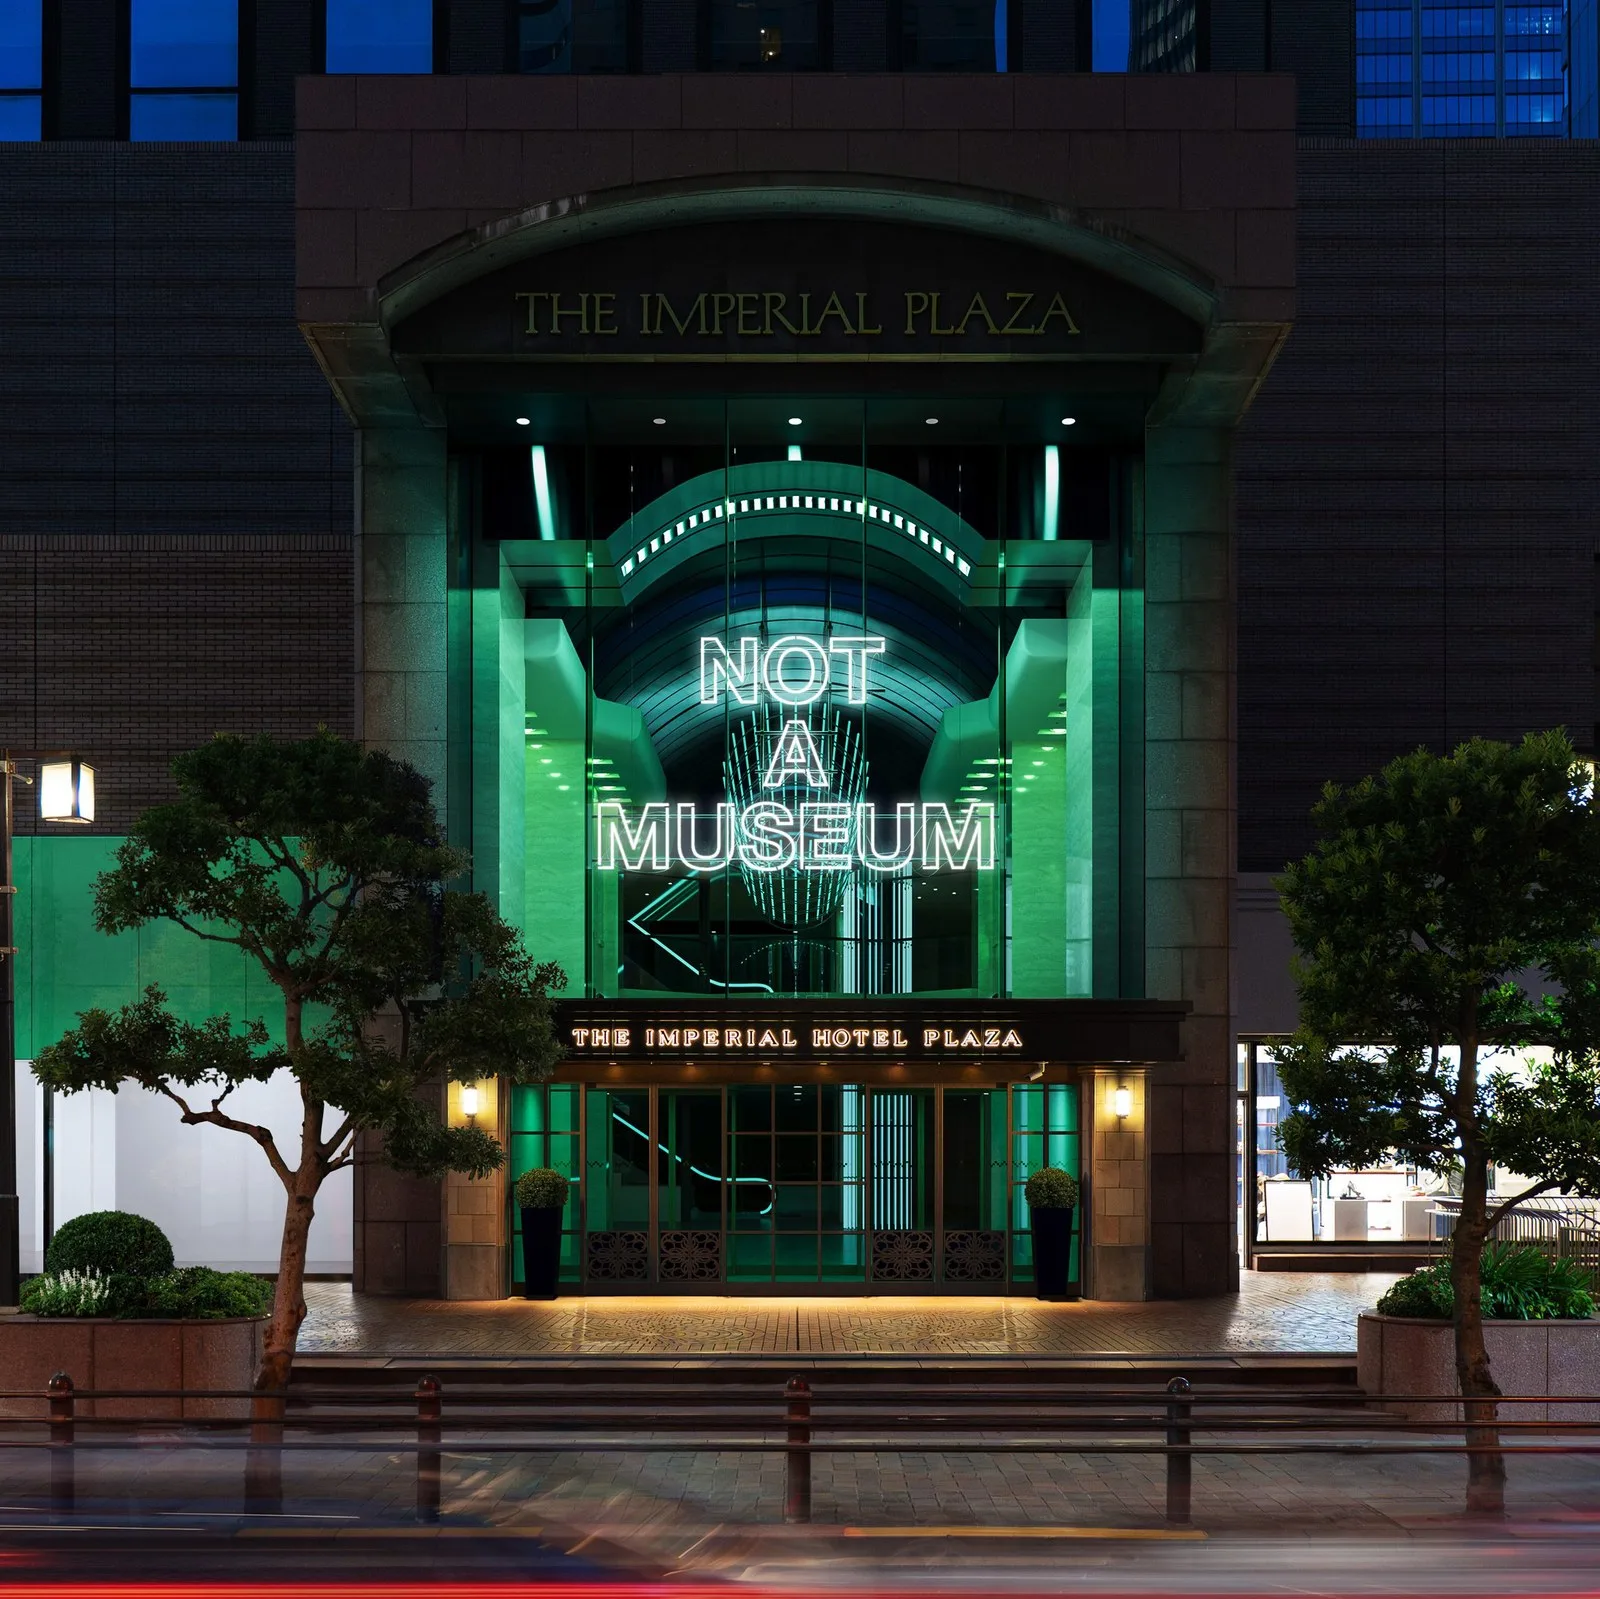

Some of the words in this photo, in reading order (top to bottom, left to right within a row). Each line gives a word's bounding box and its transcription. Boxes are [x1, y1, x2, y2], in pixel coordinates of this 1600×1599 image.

[514, 292, 618, 336] THE
[639, 291, 882, 336] IMPERIAL
[904, 291, 1080, 336] PLAZA
[699, 635, 886, 705] NOT
[763, 719, 829, 787] A
[596, 801, 995, 871] MUSEUM
[572, 1028, 630, 1047] THE
[645, 1028, 798, 1047] IMPERIAL
[812, 1028, 908, 1047] HOTEL
[924, 1028, 1023, 1047] PLAZA
